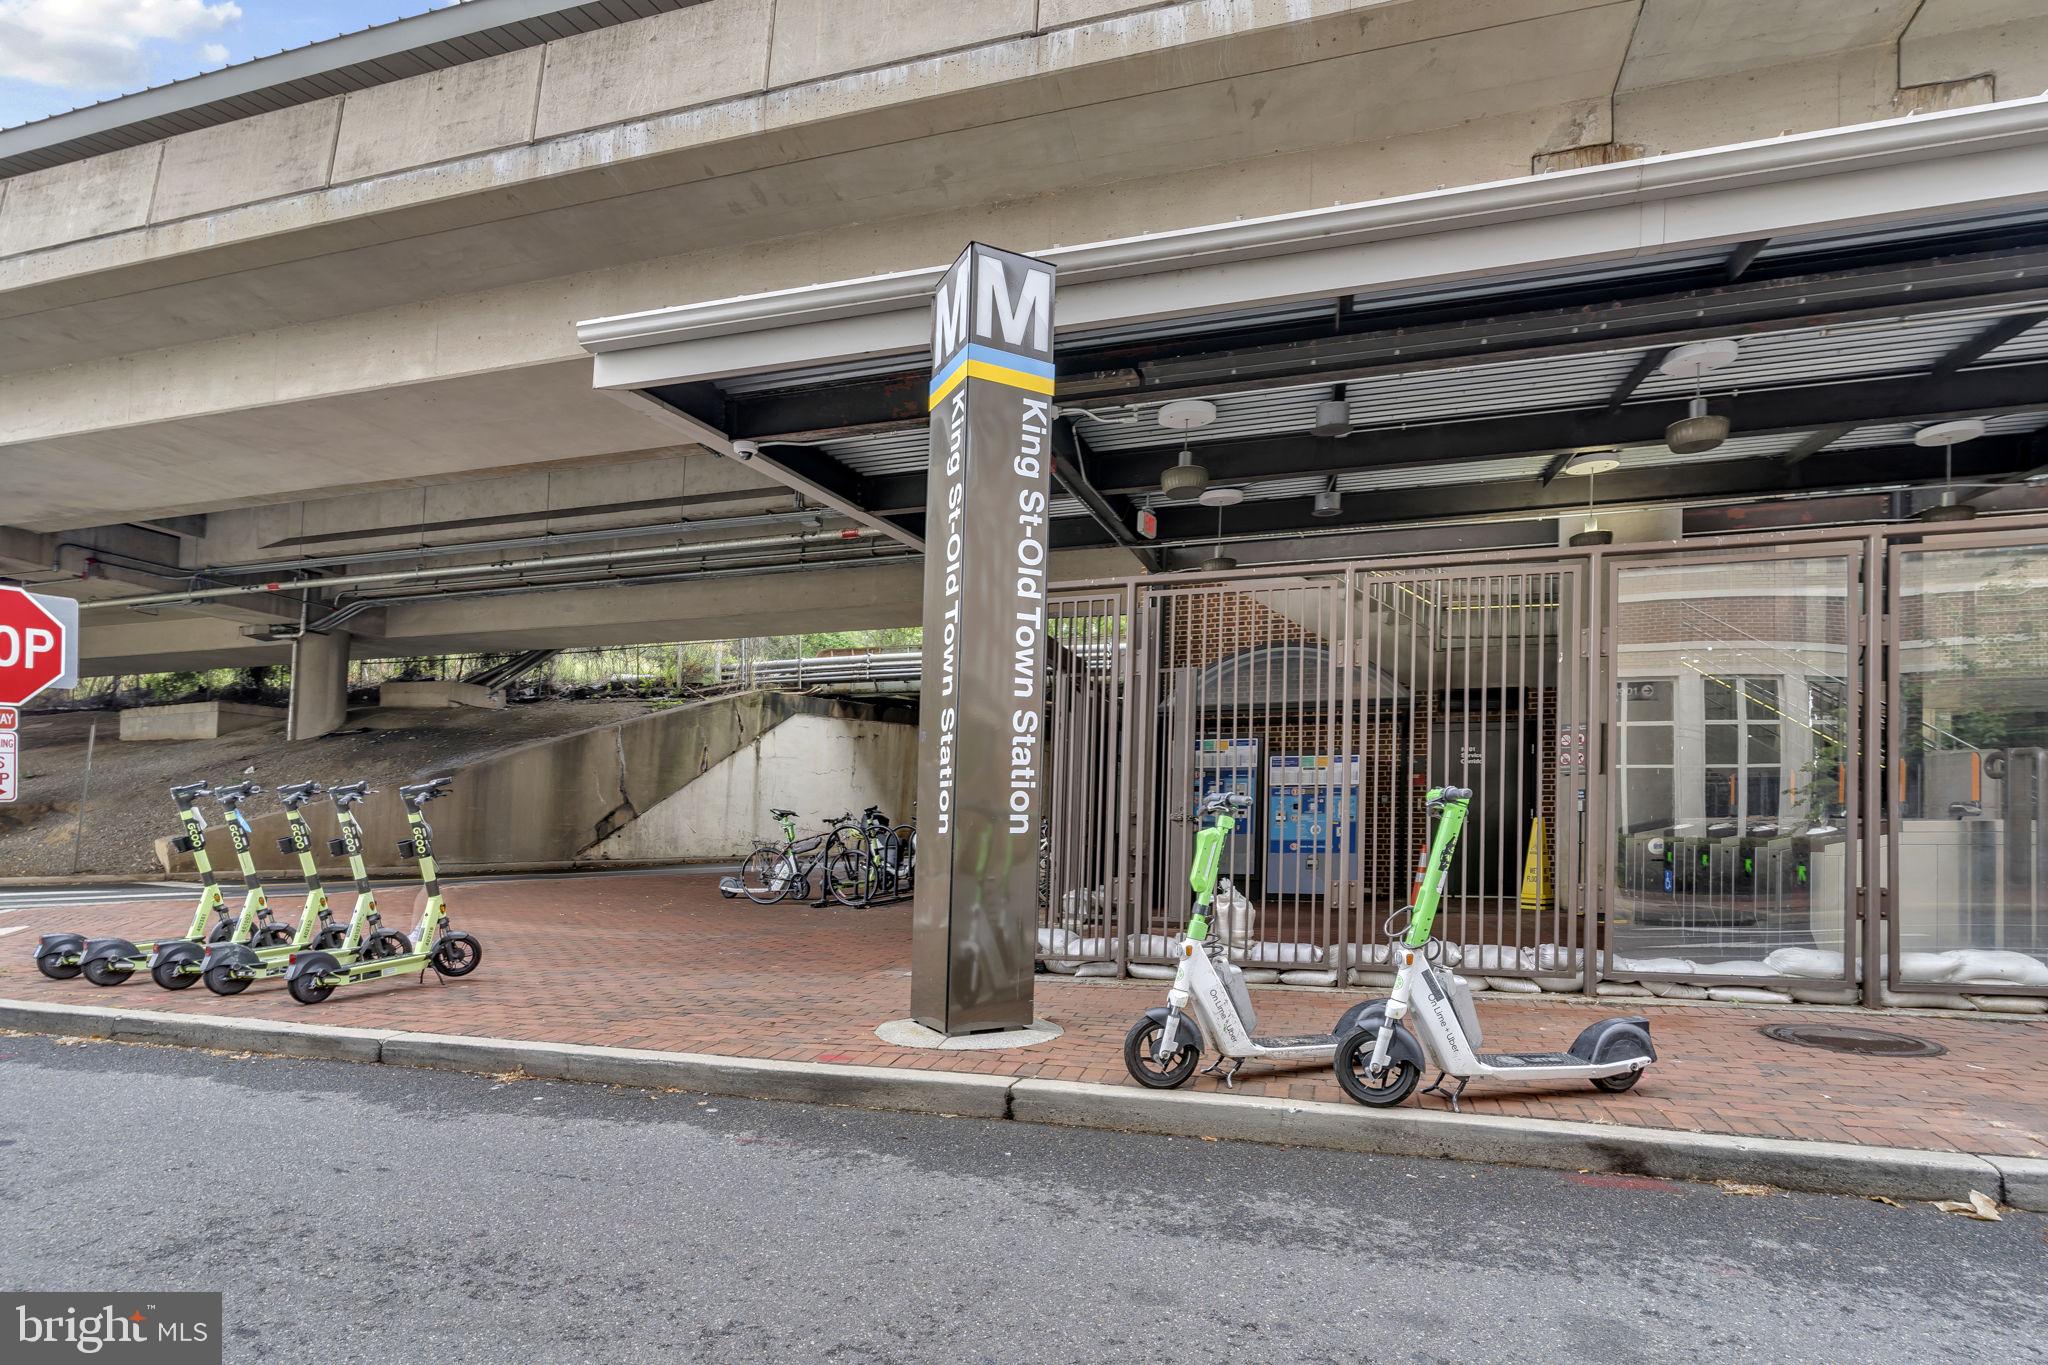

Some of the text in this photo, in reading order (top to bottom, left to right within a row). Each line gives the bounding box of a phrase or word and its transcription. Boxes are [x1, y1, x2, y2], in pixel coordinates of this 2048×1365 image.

[934, 256, 969, 369] M
[976, 254, 1051, 353] M
[938, 388, 965, 834] King St-Old Town Station
[1009, 397, 1048, 834] King St-Old Town Station
[0, 713, 14, 725] AY
[1209, 989, 1218, 1002] On
[1215, 1000, 1227, 1020] Lime
[1226, 1024, 1238, 1043] Uber
[1427, 993, 1437, 1007] On
[1433, 1005, 1447, 1027] Lime
[1446, 1032, 1459, 1053] Uber
